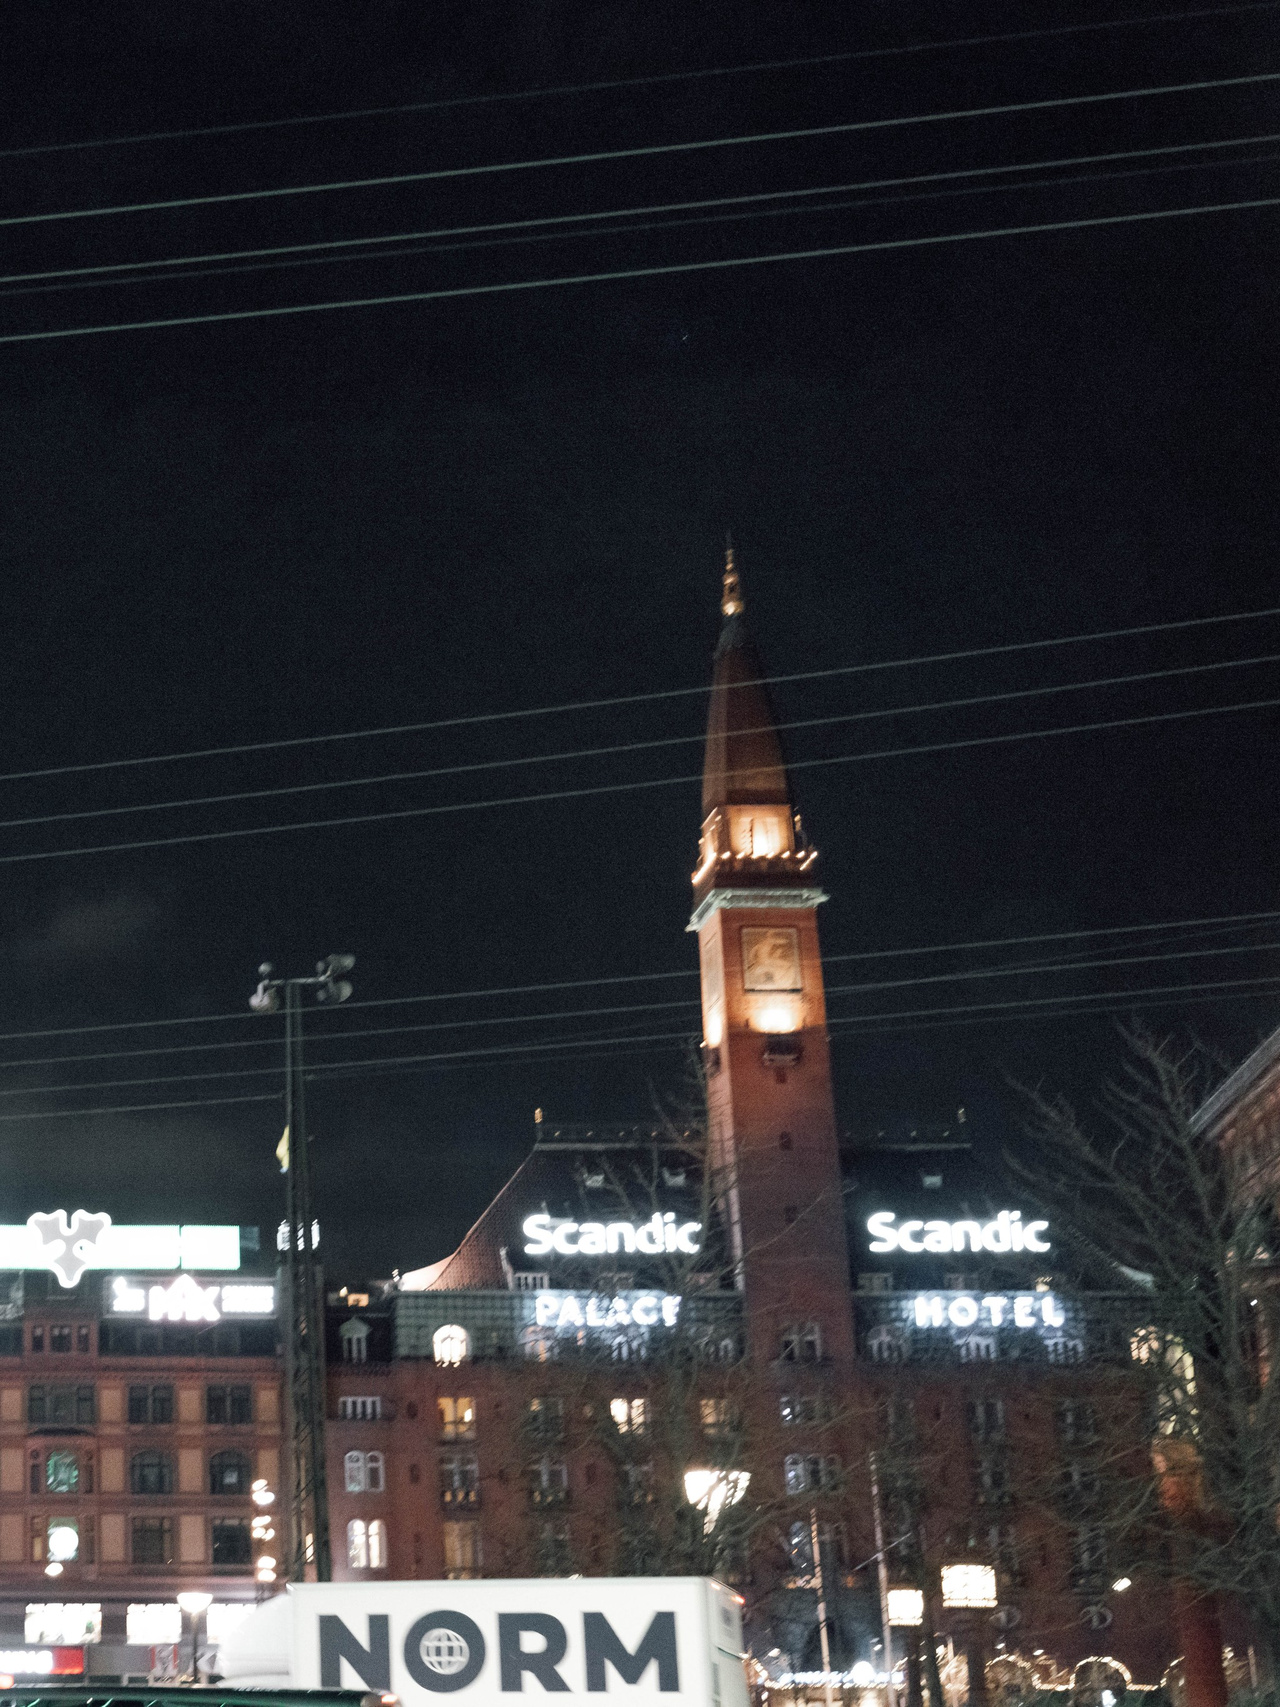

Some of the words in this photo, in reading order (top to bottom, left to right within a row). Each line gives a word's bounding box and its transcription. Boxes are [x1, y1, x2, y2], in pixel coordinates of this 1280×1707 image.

[523, 1212, 702, 1254] Scandic
[867, 1210, 1051, 1252] Scandic
[914, 1296, 1065, 1328] HOTEL
[318, 1610, 681, 1693] NORM
